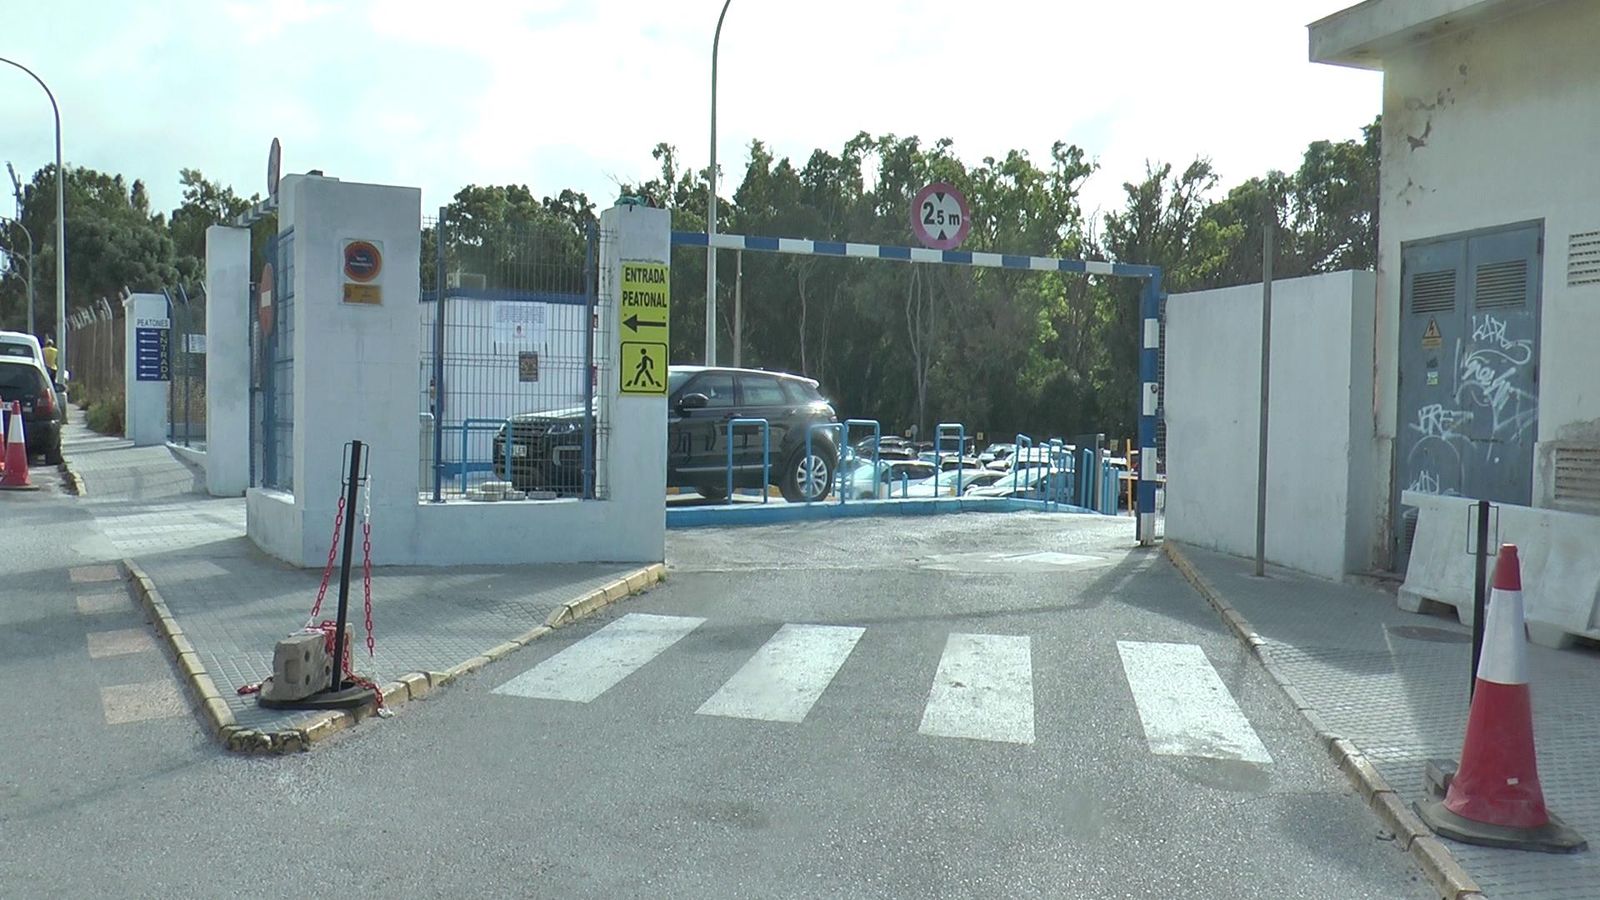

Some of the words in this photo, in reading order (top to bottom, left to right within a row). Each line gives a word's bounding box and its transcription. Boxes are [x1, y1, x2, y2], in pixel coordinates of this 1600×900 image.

[948, 213, 960, 226] m
[625, 267, 666, 284] ENTRADA
[622, 290, 667, 308] PEATONAL
[136, 318, 169, 327] PEATONES
[160, 329, 169, 380] ENTRADA
